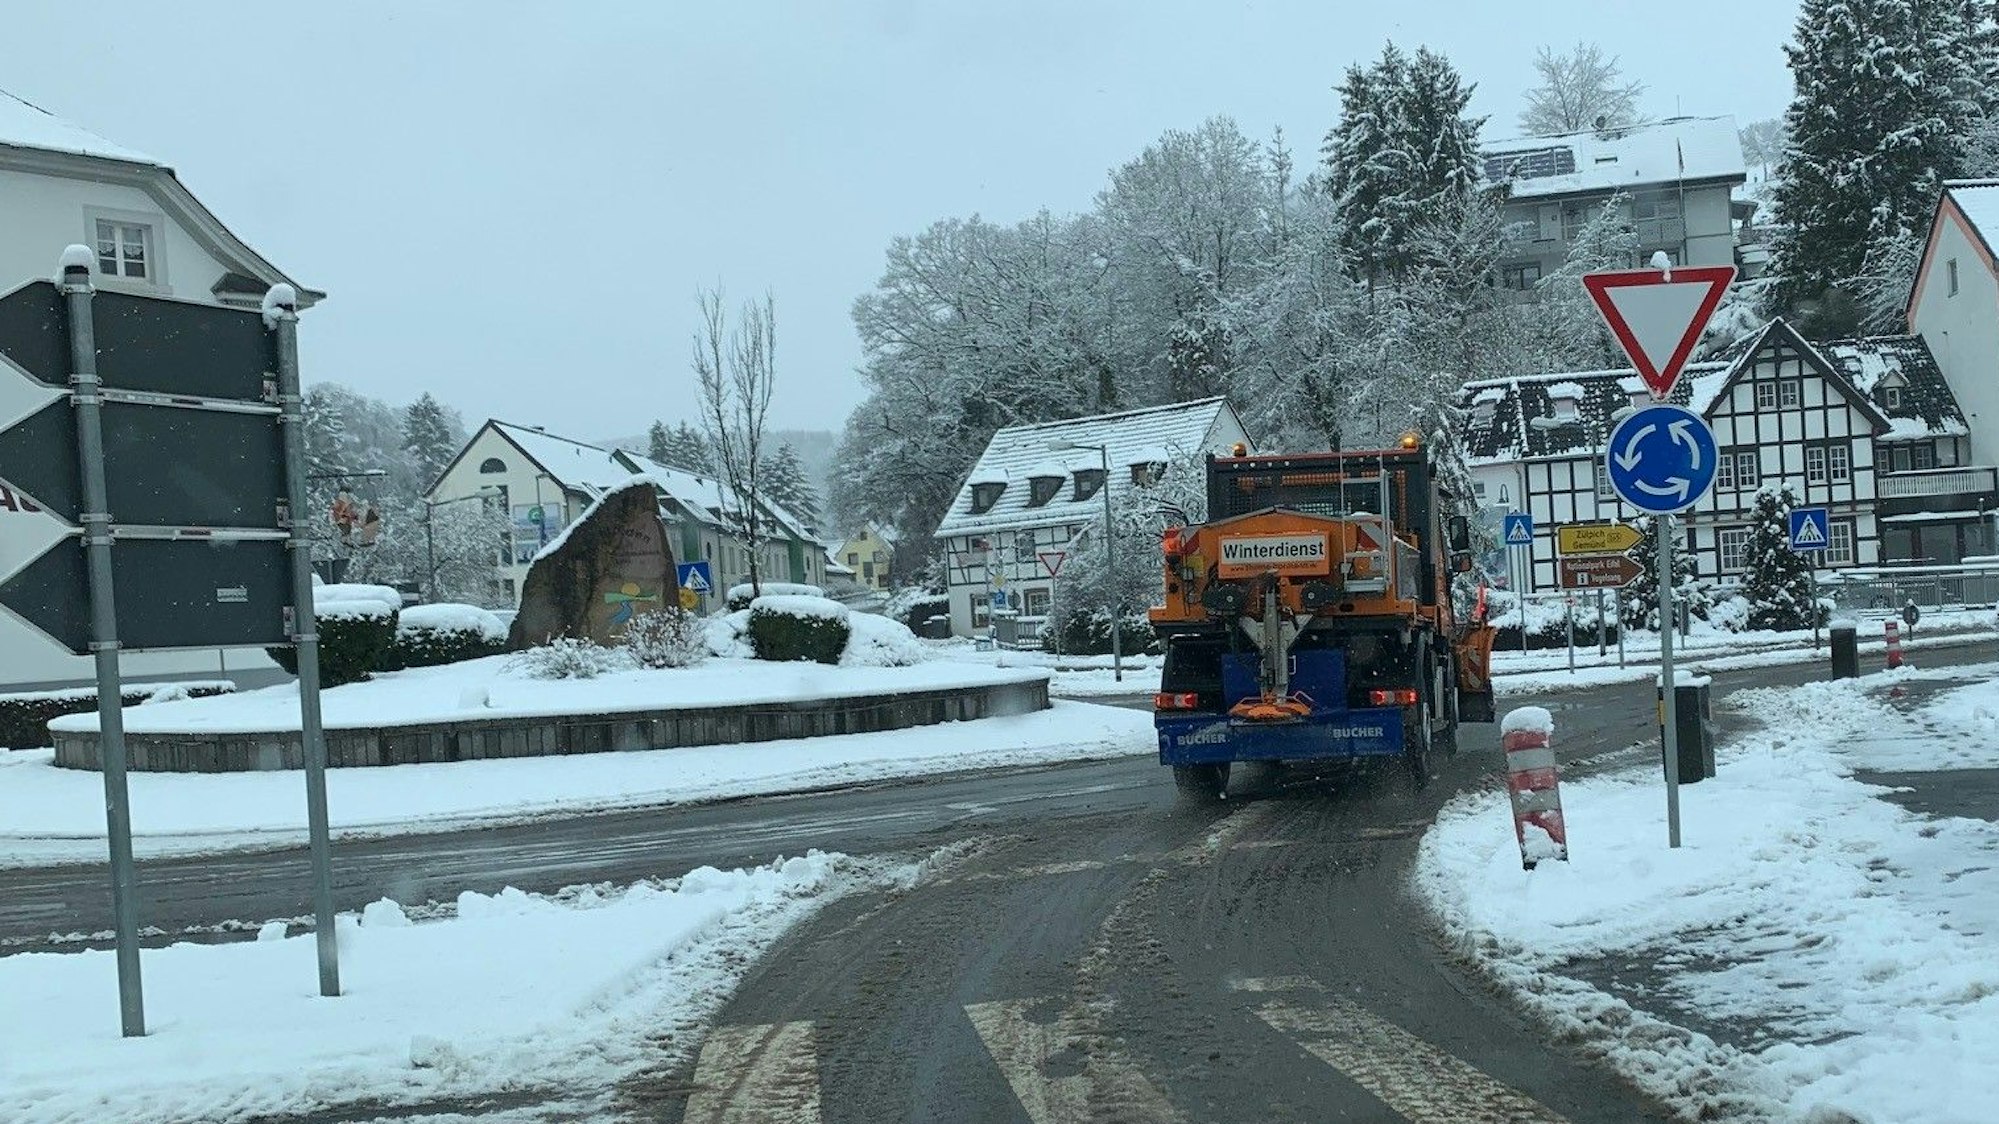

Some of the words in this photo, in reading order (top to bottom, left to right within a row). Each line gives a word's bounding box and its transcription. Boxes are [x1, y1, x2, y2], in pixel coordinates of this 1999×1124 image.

[1223, 541, 1324, 559] Winterdienst
[1333, 727, 1384, 738] BUCHER
[1177, 733, 1227, 746] BUCHER
